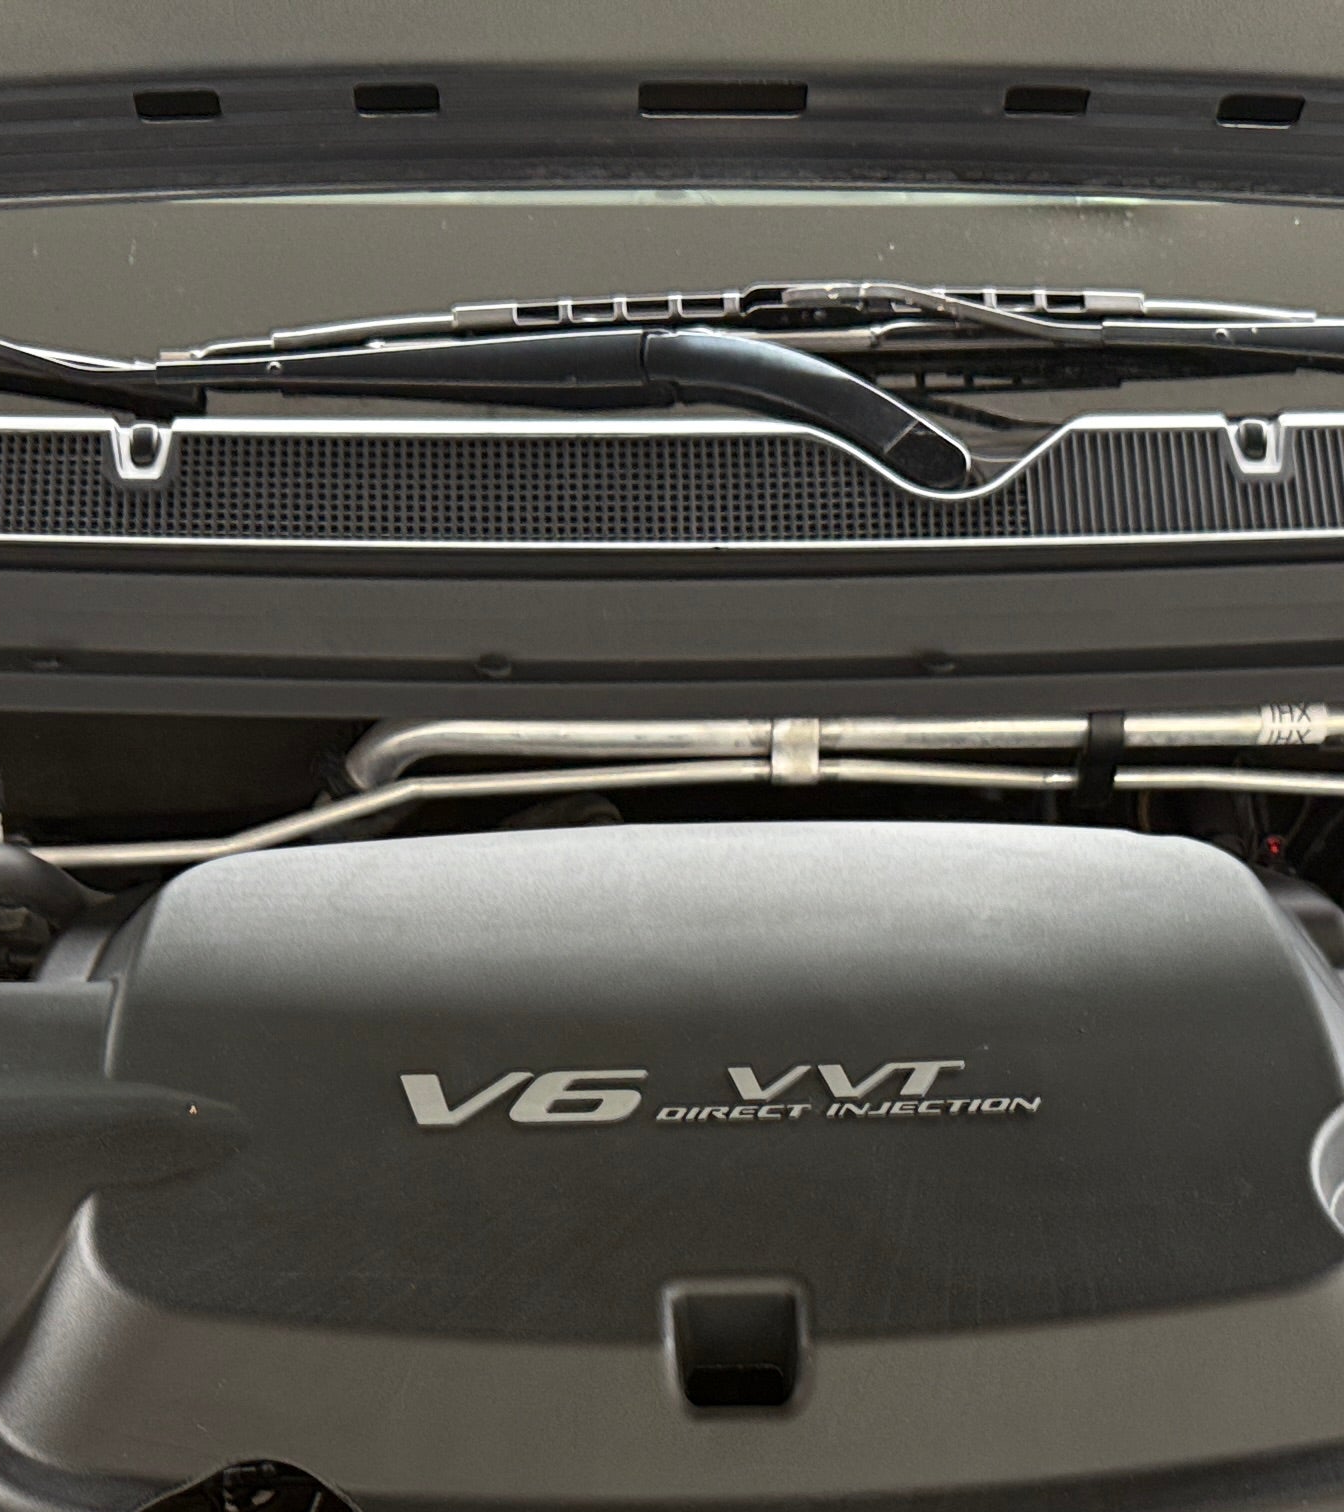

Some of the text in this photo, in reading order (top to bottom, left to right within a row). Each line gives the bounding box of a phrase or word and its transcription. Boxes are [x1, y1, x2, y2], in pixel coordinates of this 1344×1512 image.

[399, 1060, 966, 1126] V6 VVT
[655, 1096, 1042, 1122] DIRECT INJECTION
